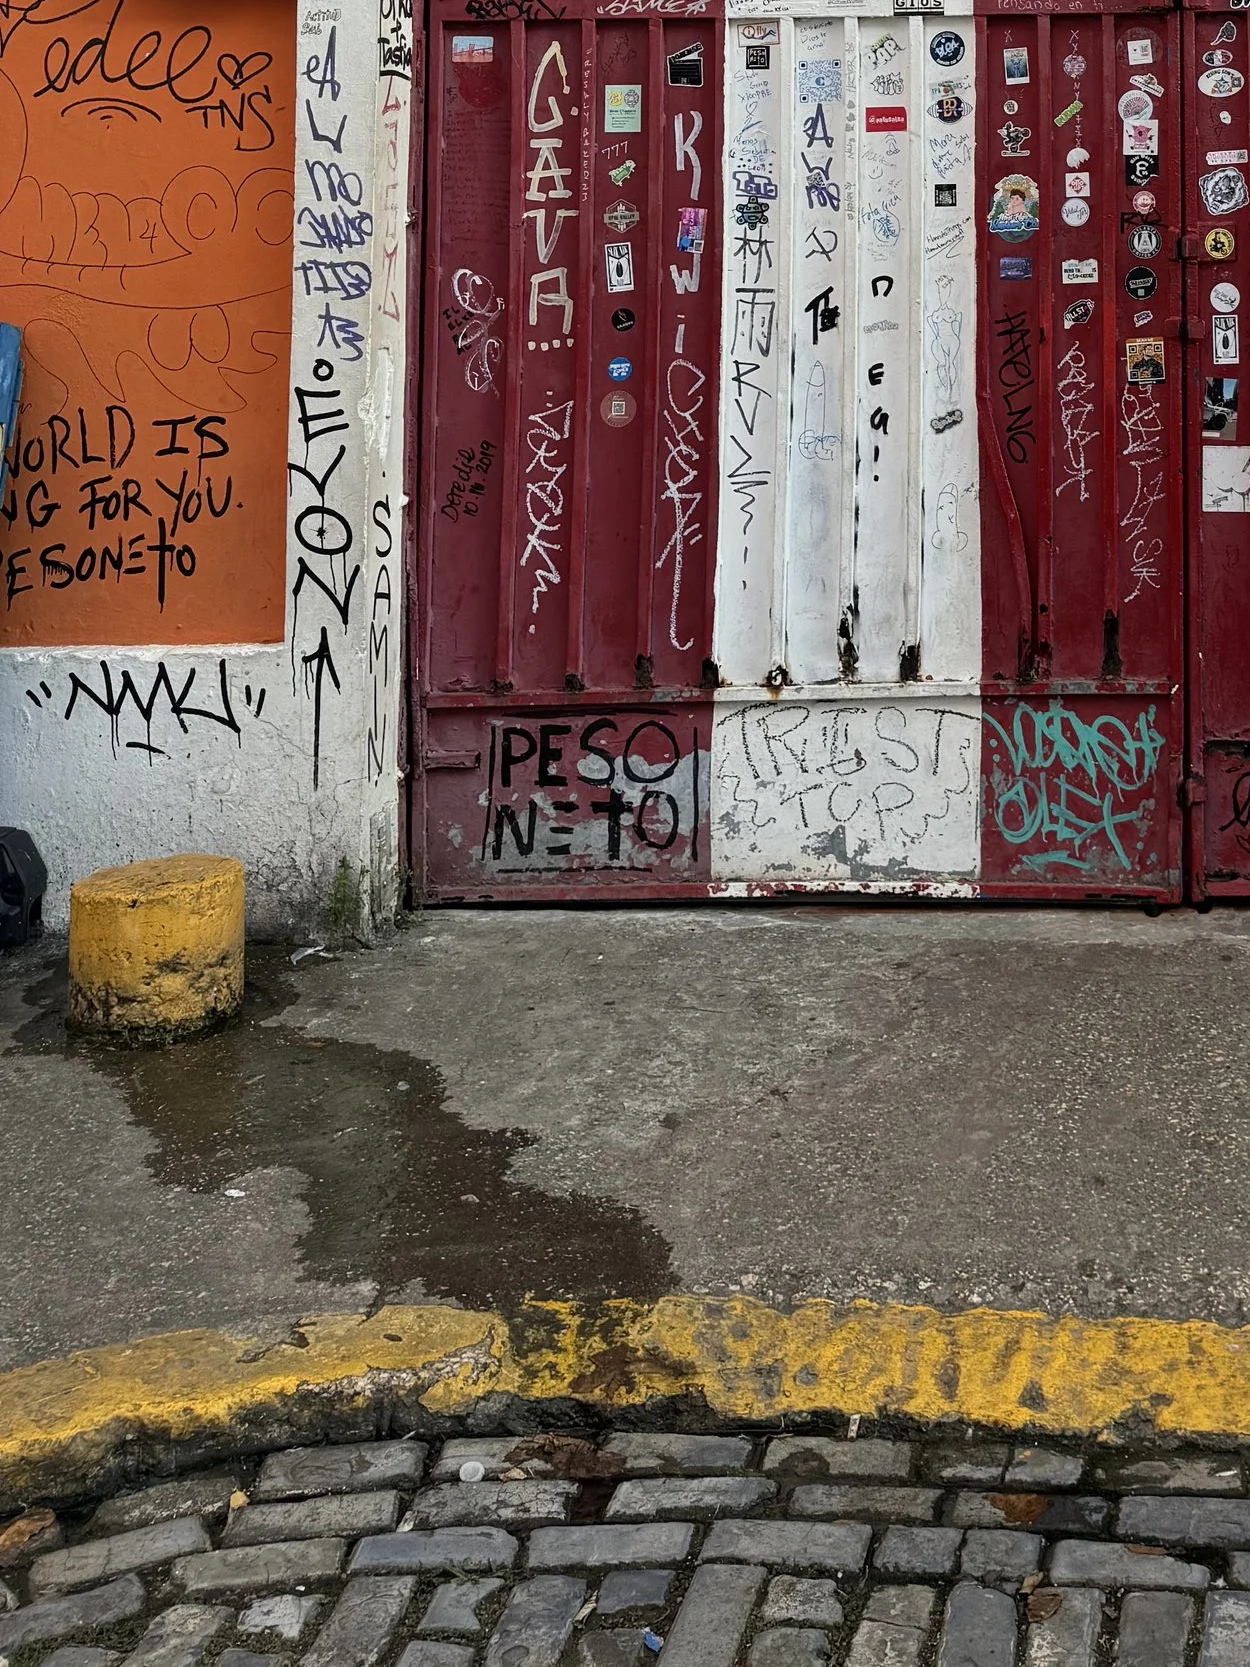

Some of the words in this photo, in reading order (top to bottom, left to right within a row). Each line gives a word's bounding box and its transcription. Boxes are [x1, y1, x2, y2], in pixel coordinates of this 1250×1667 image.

[1069, 1, 1083, 10] en
[601, 141, 629, 160] 777
[153, 414, 230, 460] IS
[79, 474, 152, 531] FOR
[501, 717, 680, 788] PESO
